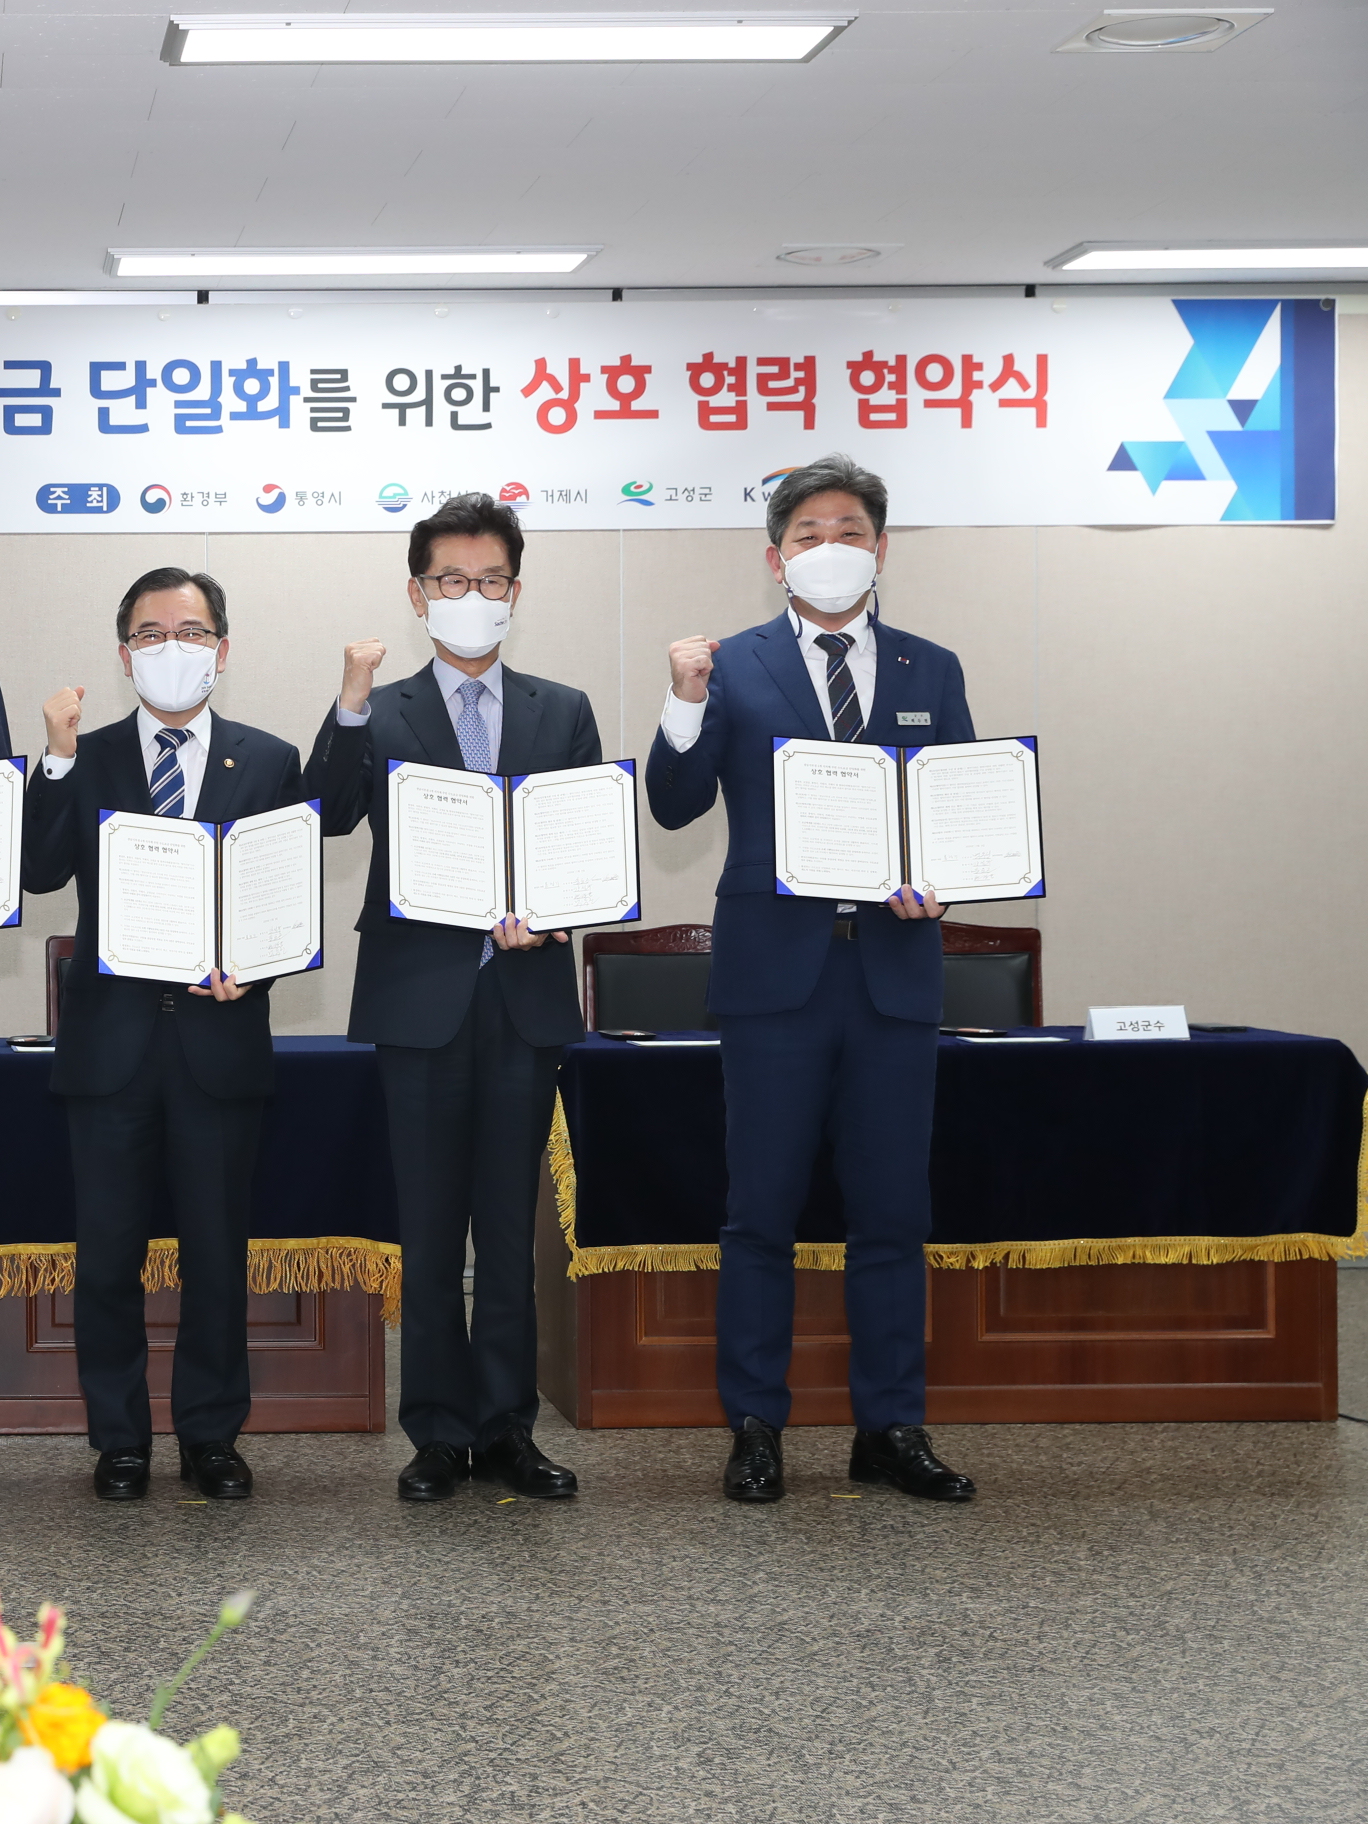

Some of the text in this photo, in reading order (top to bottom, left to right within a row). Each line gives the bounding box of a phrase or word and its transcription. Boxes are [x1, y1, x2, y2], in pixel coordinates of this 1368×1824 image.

[89, 357, 357, 436] 단일화를
[381, 364, 501, 432] 위한
[520, 353, 660, 435] 상호
[685, 350, 818, 432] 협력
[845, 348, 1049, 431] 협약식
[180, 491, 228, 507] 환경부
[294, 491, 342, 506] 통영시
[421, 490, 468, 505] 사천
[540, 489, 588, 504] 거제시
[664, 486, 713, 502] 고성군
[1116, 1020, 1166, 1032] 고성군수
